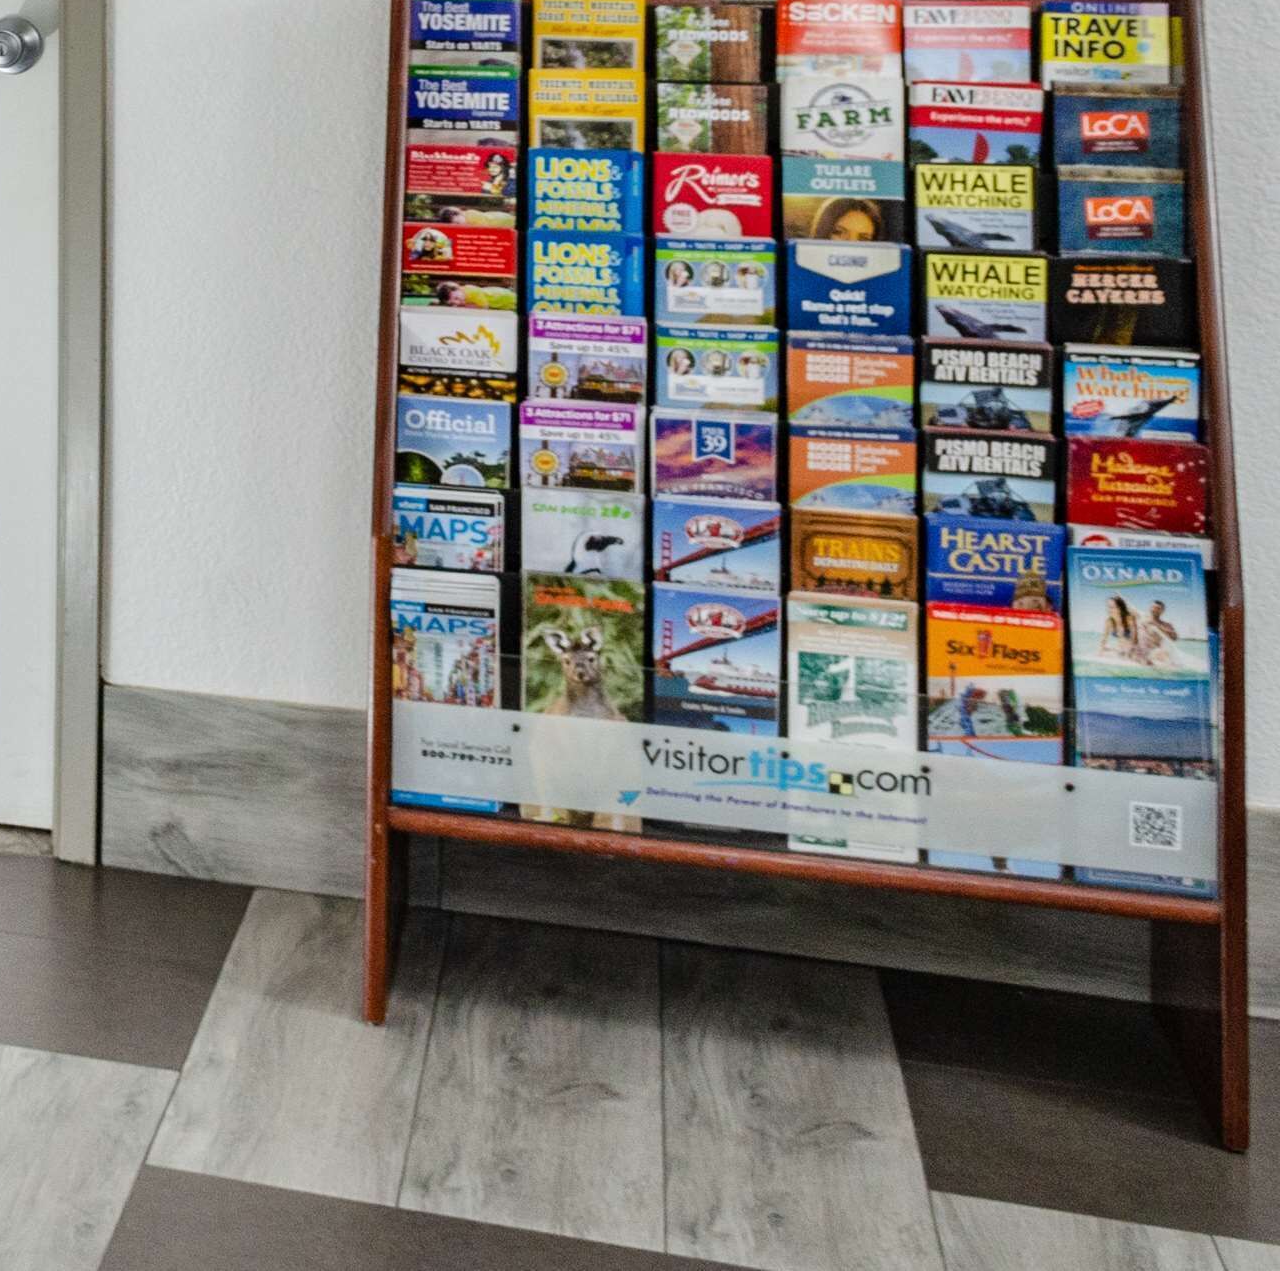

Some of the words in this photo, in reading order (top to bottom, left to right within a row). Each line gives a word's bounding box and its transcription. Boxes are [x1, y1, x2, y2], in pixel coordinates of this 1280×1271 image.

[1070, 1, 1139, 14] ONLINE
[417, 13, 512, 32] YOSEMITE
[1050, 17, 1155, 39] TRAVEL
[668, 29, 749, 42] REDWOODS
[1053, 40, 1125, 59] INFO
[414, 91, 510, 111] YOSEMITE
[668, 107, 751, 122] REDWOODS
[797, 106, 893, 129] FARM
[535, 156, 612, 181] LIONS
[815, 163, 872, 177] TULARE
[535, 180, 614, 201] FOSSILS
[810, 178, 876, 192] OUTLETS
[921, 172, 1028, 194] WHALE
[926, 194, 1023, 208] WATCHING
[533, 241, 611, 267] LIONS
[533, 264, 613, 286] FOSSILS
[932, 262, 1042, 286] WHALE
[1071, 273, 1159, 289] MERCER
[937, 284, 1035, 300] WATCHING
[1065, 289, 1166, 305] CAVERNS
[409, 344, 457, 358] BLACK
[460, 347, 491, 360] OAK
[931, 348, 985, 368] PISMO
[987, 351, 1043, 372] BEACH
[934, 364, 967, 381] ATV
[967, 366, 1038, 386] RENTALS
[1076, 365, 1150, 383] Whale
[1076, 382, 1190, 404] Watching
[405, 409, 496, 435] Official
[701, 434, 728, 453] 39
[935, 438, 989, 458] PISMO
[991, 441, 1046, 463] BEACH
[938, 454, 970, 472] ATV
[971, 456, 1042, 477] RENTALS
[399, 514, 489, 544] MAPS
[811, 535, 902, 563] TRAINS
[940, 527, 1051, 554] HEARST
[948, 548, 1047, 576] CASTLE
[1081, 564, 1185, 583] OXNARD
[397, 613, 488, 635] MAPS
[946, 639, 975, 656] Six
[992, 643, 1041, 664] Flags
[645, 786, 702, 802] Delivering
[704, 792, 723, 803] the
[727, 795, 762, 808] Power
[780, 801, 837, 816] Brochures
[855, 809, 874, 820] the
